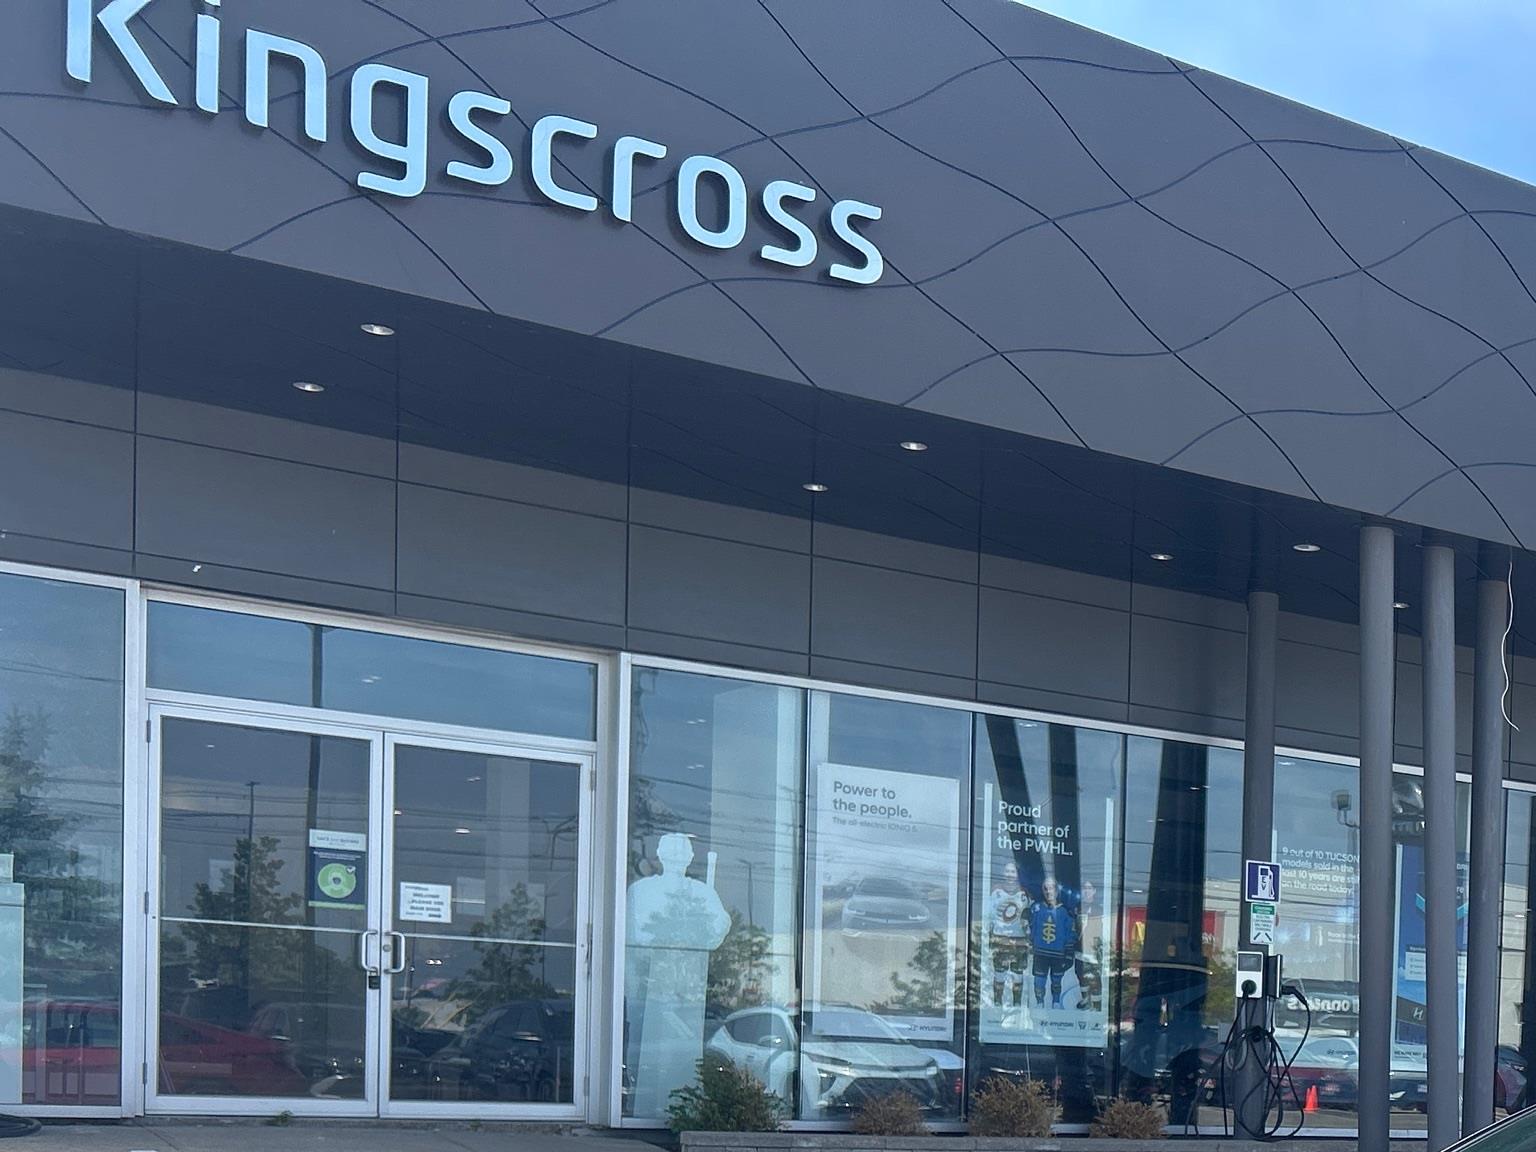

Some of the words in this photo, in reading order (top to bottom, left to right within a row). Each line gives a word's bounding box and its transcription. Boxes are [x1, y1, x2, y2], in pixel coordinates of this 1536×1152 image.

[65, 0, 884, 285] Kingscross
[833, 780, 879, 798] Power
[881, 787, 896, 800] to
[832, 798, 857, 812] the
[860, 803, 912, 818] people.
[999, 800, 1041, 818] Proud
[998, 821, 1052, 836] partner
[1054, 825, 1070, 838] of
[997, 835, 1021, 851] the
[1025, 838, 1073, 856] PWHL.
[1282, 846, 1288, 856] 9
[1305, 849, 1314, 858] of
[1315, 850, 1324, 859] 10
[1325, 851, 1359, 864] TUCSON
[1281, 859, 1312, 869] models
[1313, 861, 1331, 871] sold
[1340, 864, 1354, 873] the
[1294, 880, 1307, 889] the
[1298, 869, 1307, 879] 10
[1308, 871, 1331, 881] years
[1332, 874, 1346, 883] are
